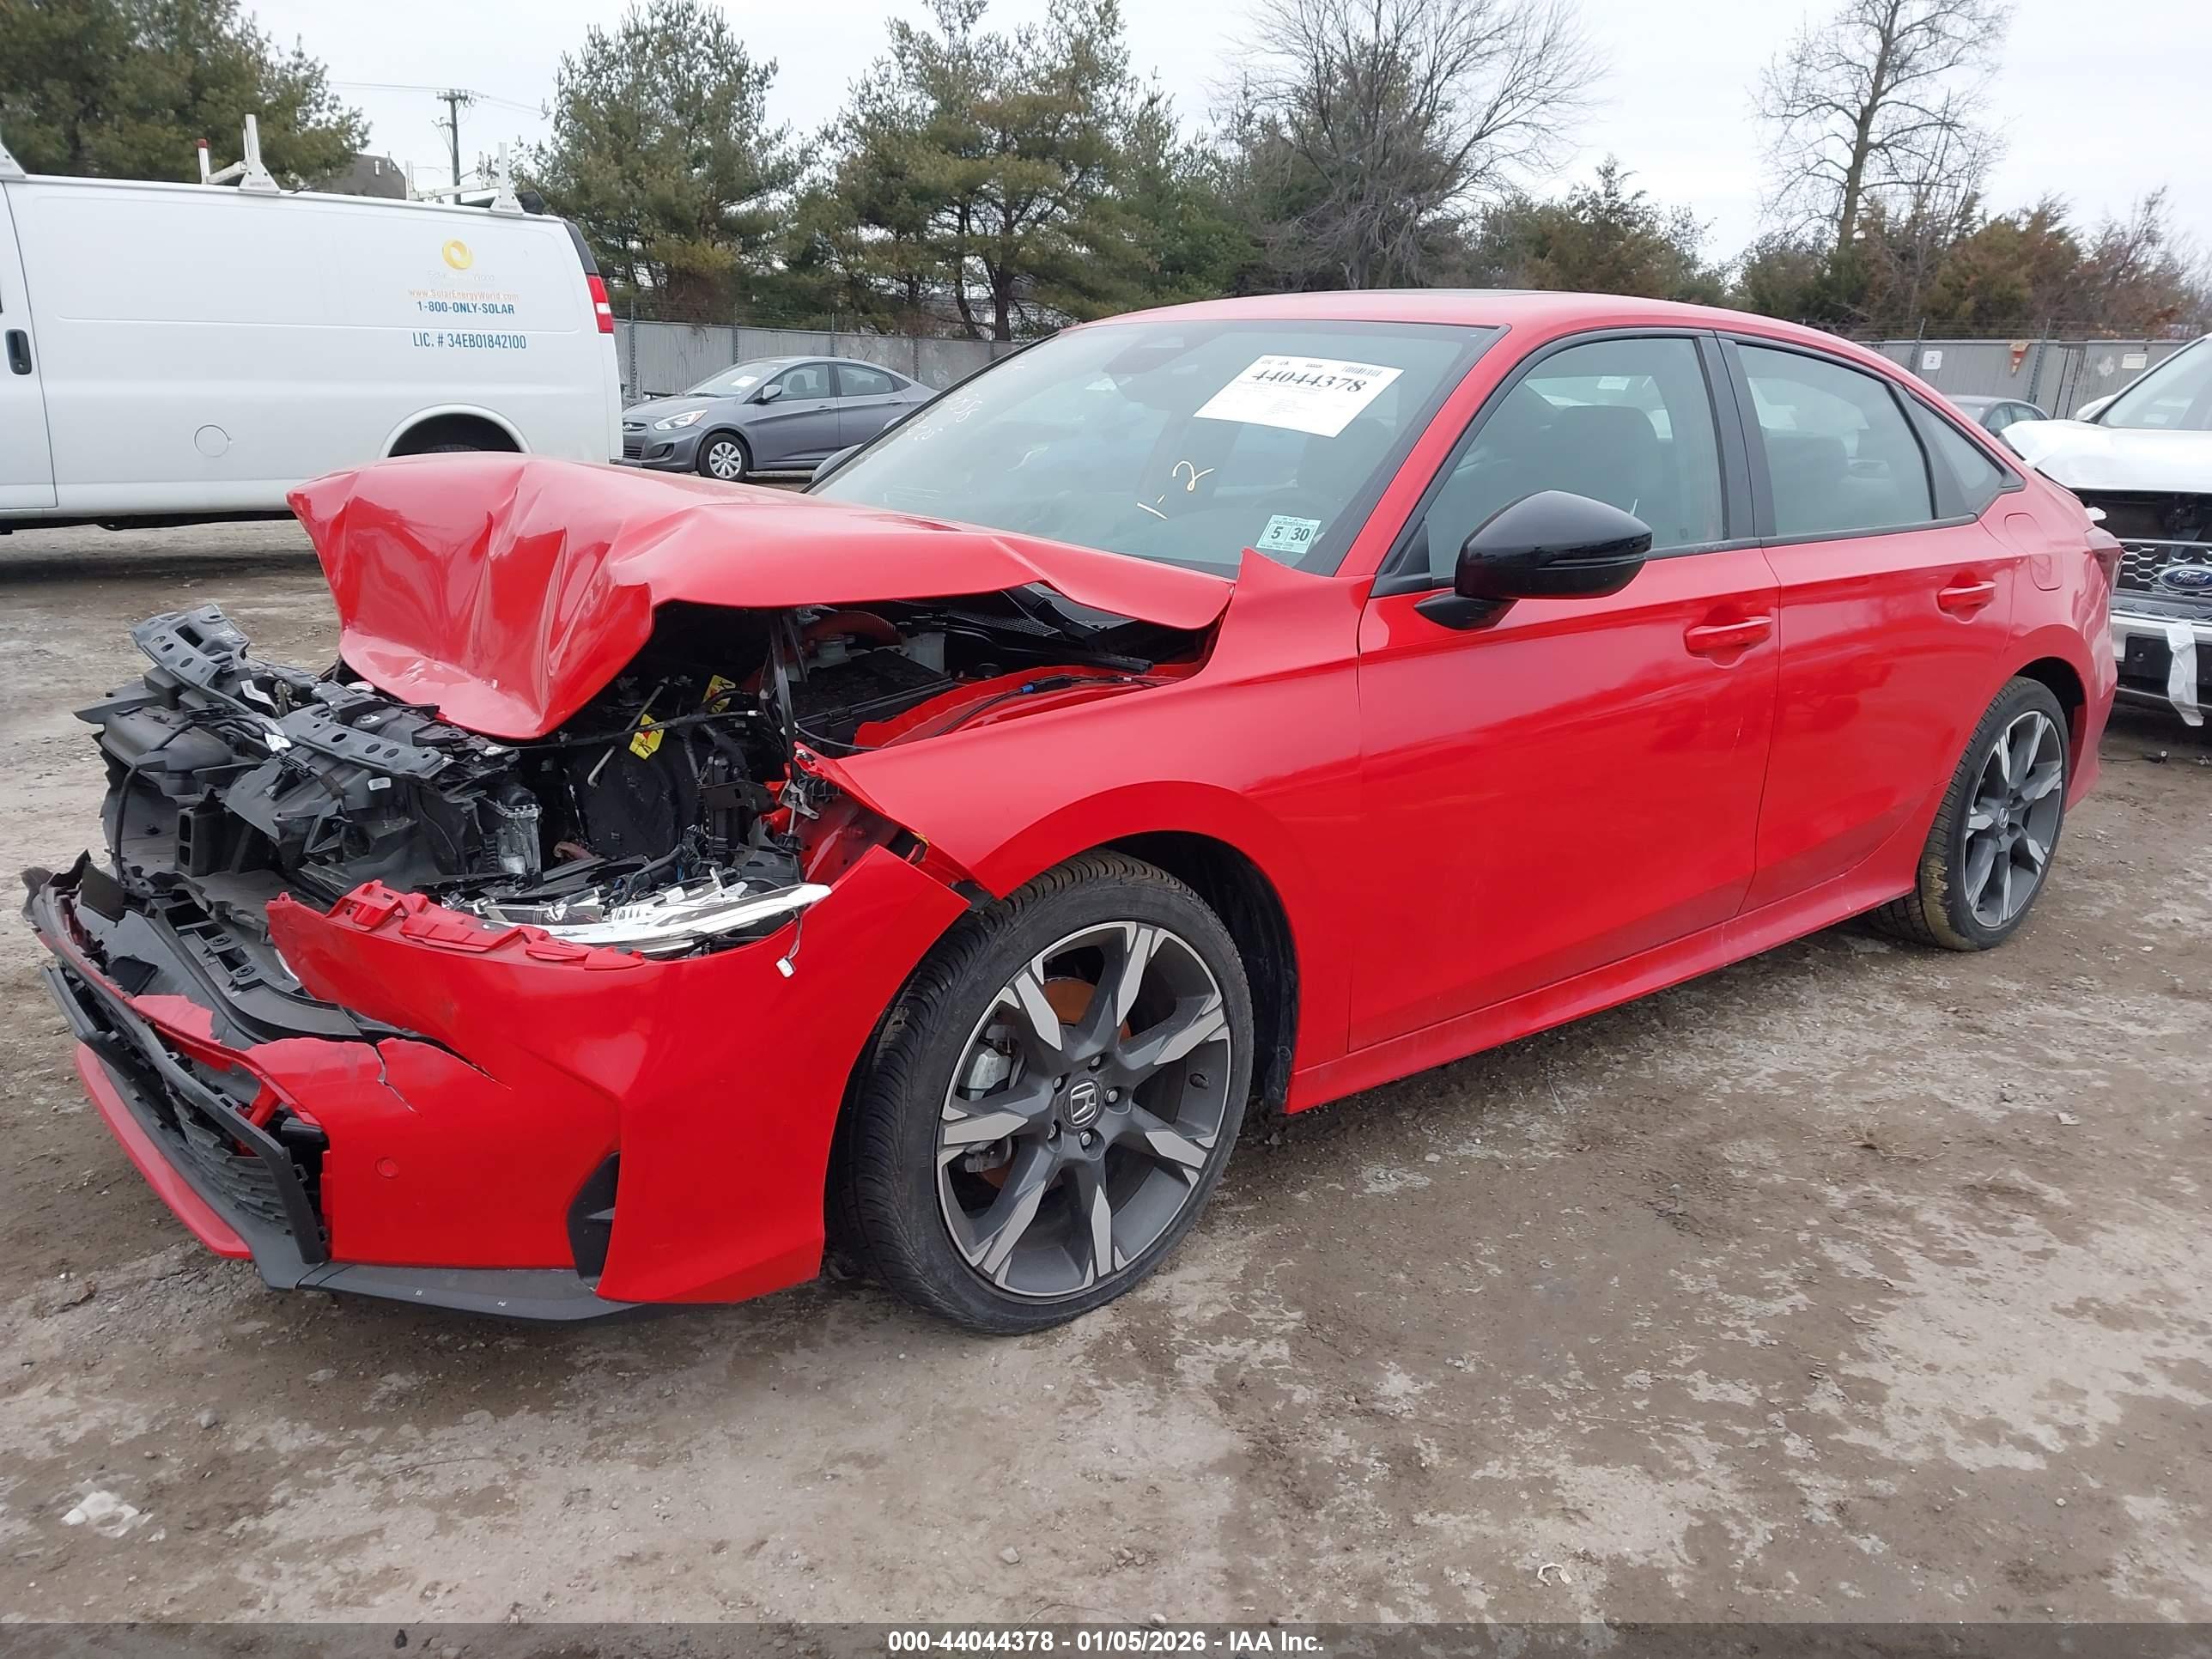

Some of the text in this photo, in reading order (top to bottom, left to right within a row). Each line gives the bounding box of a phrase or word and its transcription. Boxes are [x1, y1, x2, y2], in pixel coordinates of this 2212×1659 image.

[416, 301, 515, 314] 1-800-ONLY-SOLAR
[412, 331, 526, 349] LIC. # 34EB01842100
[1251, 369, 1368, 392] 44044378
[1271, 526, 1310, 541] 5 30
[2173, 570, 2209, 585] Ford
